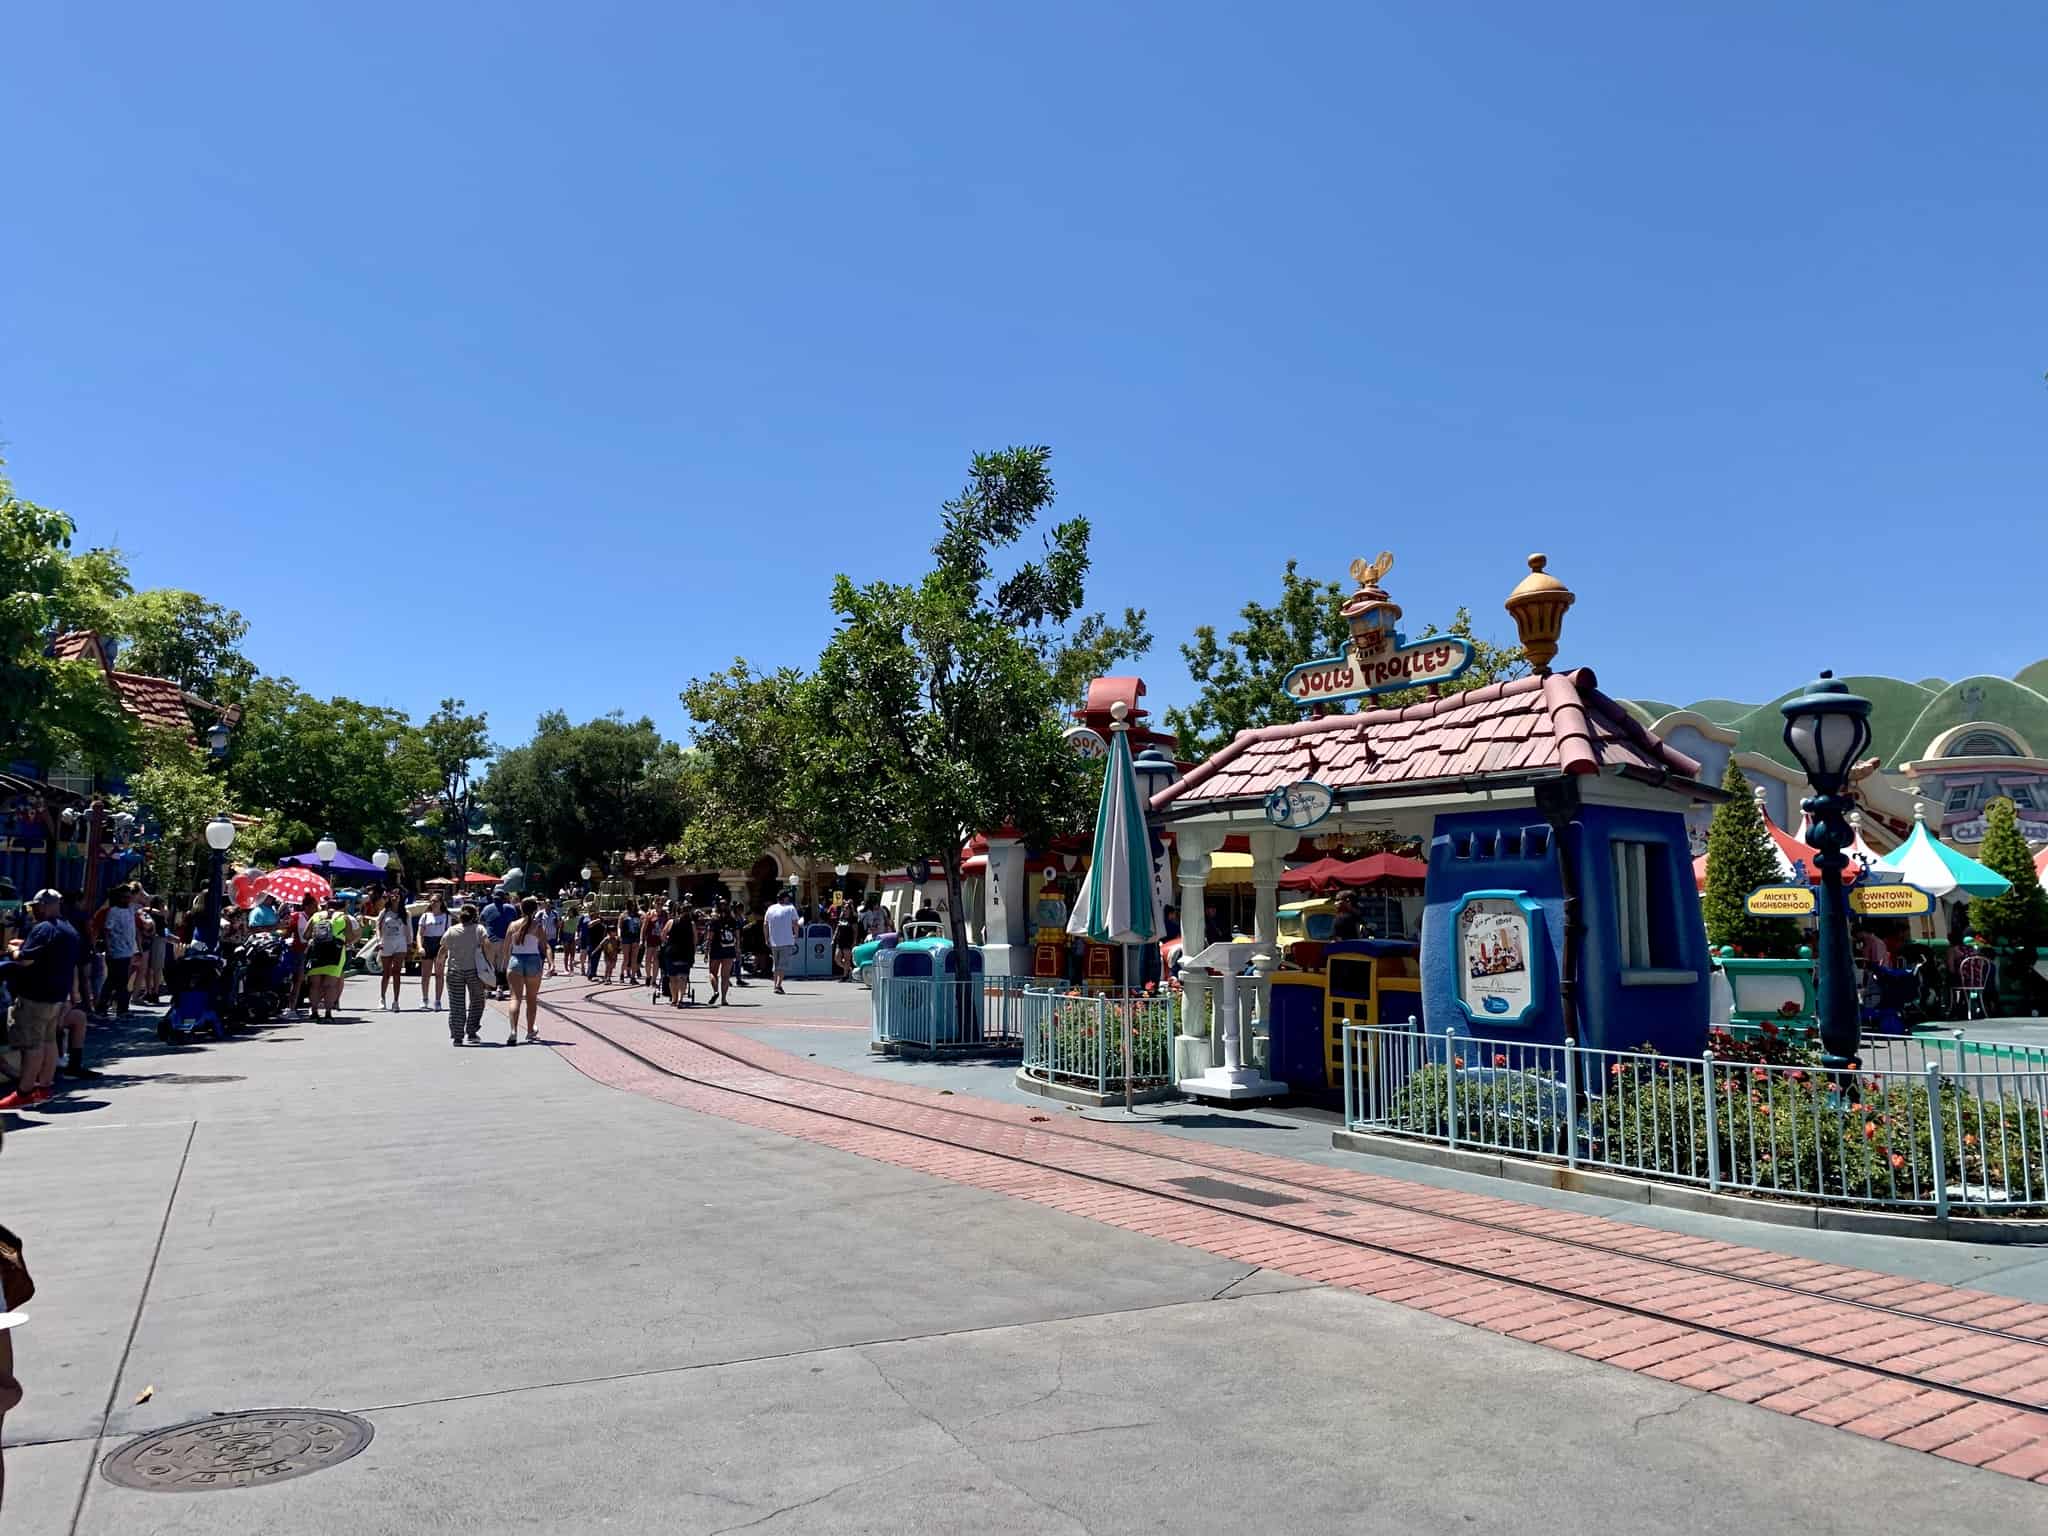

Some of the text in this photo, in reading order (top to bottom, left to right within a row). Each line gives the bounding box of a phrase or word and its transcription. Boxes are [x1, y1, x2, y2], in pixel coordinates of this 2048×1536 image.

[1298, 645, 1450, 696] JOLLY TROLLEY
[1764, 892, 1798, 901] MICKEY'S
[1856, 890, 1913, 900] DOWNTOWN
[1750, 901, 1810, 910] NEIGHBORHOOD
[1860, 901, 1913, 910] TOONTOWN
